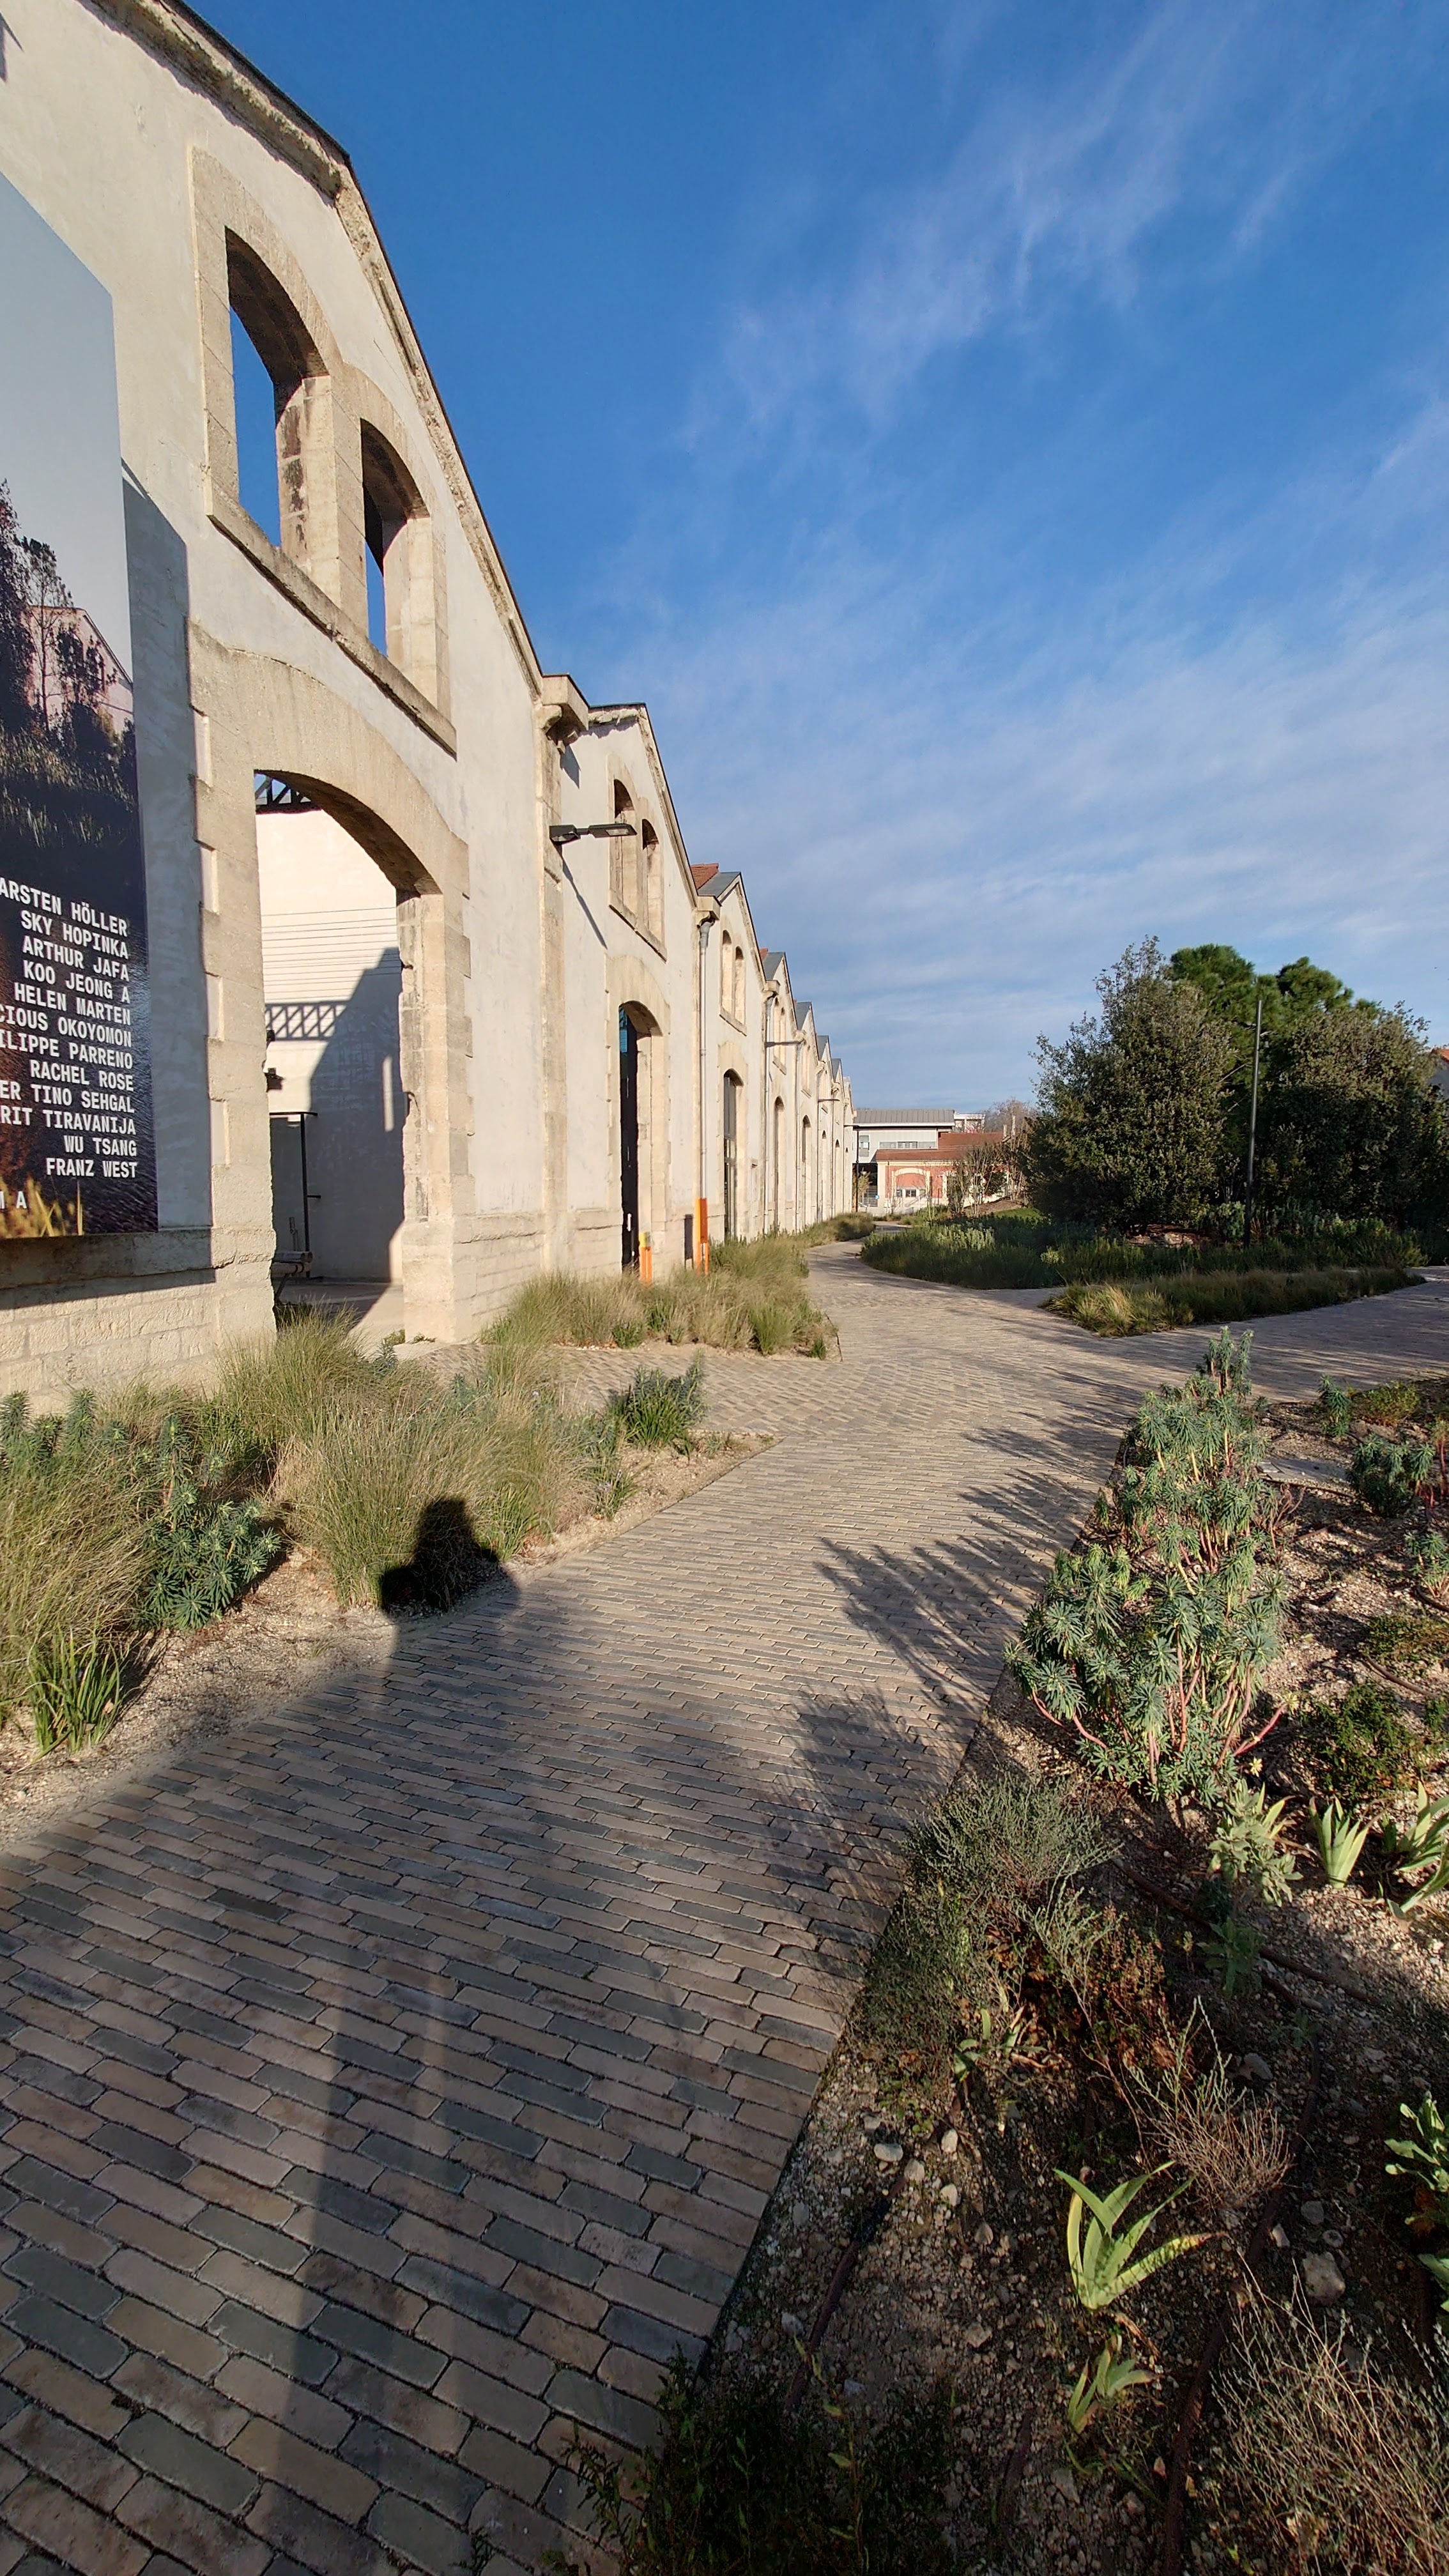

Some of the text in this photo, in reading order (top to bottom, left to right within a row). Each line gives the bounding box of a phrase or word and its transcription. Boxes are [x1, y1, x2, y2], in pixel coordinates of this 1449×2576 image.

[0, 877, 128, 937] ARSTEN HÖLLER
[20, 910, 128, 960] SKY HOPINKA
[22, 935, 130, 981] ARTHUR JAFA
[23, 960, 130, 1004] KOO JEONG A
[14, 982, 131, 1025] HELEN MARTEN
[58, 1016, 132, 1048] OKOYOMON
[68, 1042, 133, 1070] PARRENO
[29, 1059, 134, 1092] RACHEL ROSE
[0, 1080, 135, 1113] ER TINO SEHGAL
[0, 1105, 136, 1135] RIT TIRAVANIJA
[63, 1135, 137, 1157] WU TSANG
[46, 1158, 137, 1178] FRANZ WEST
